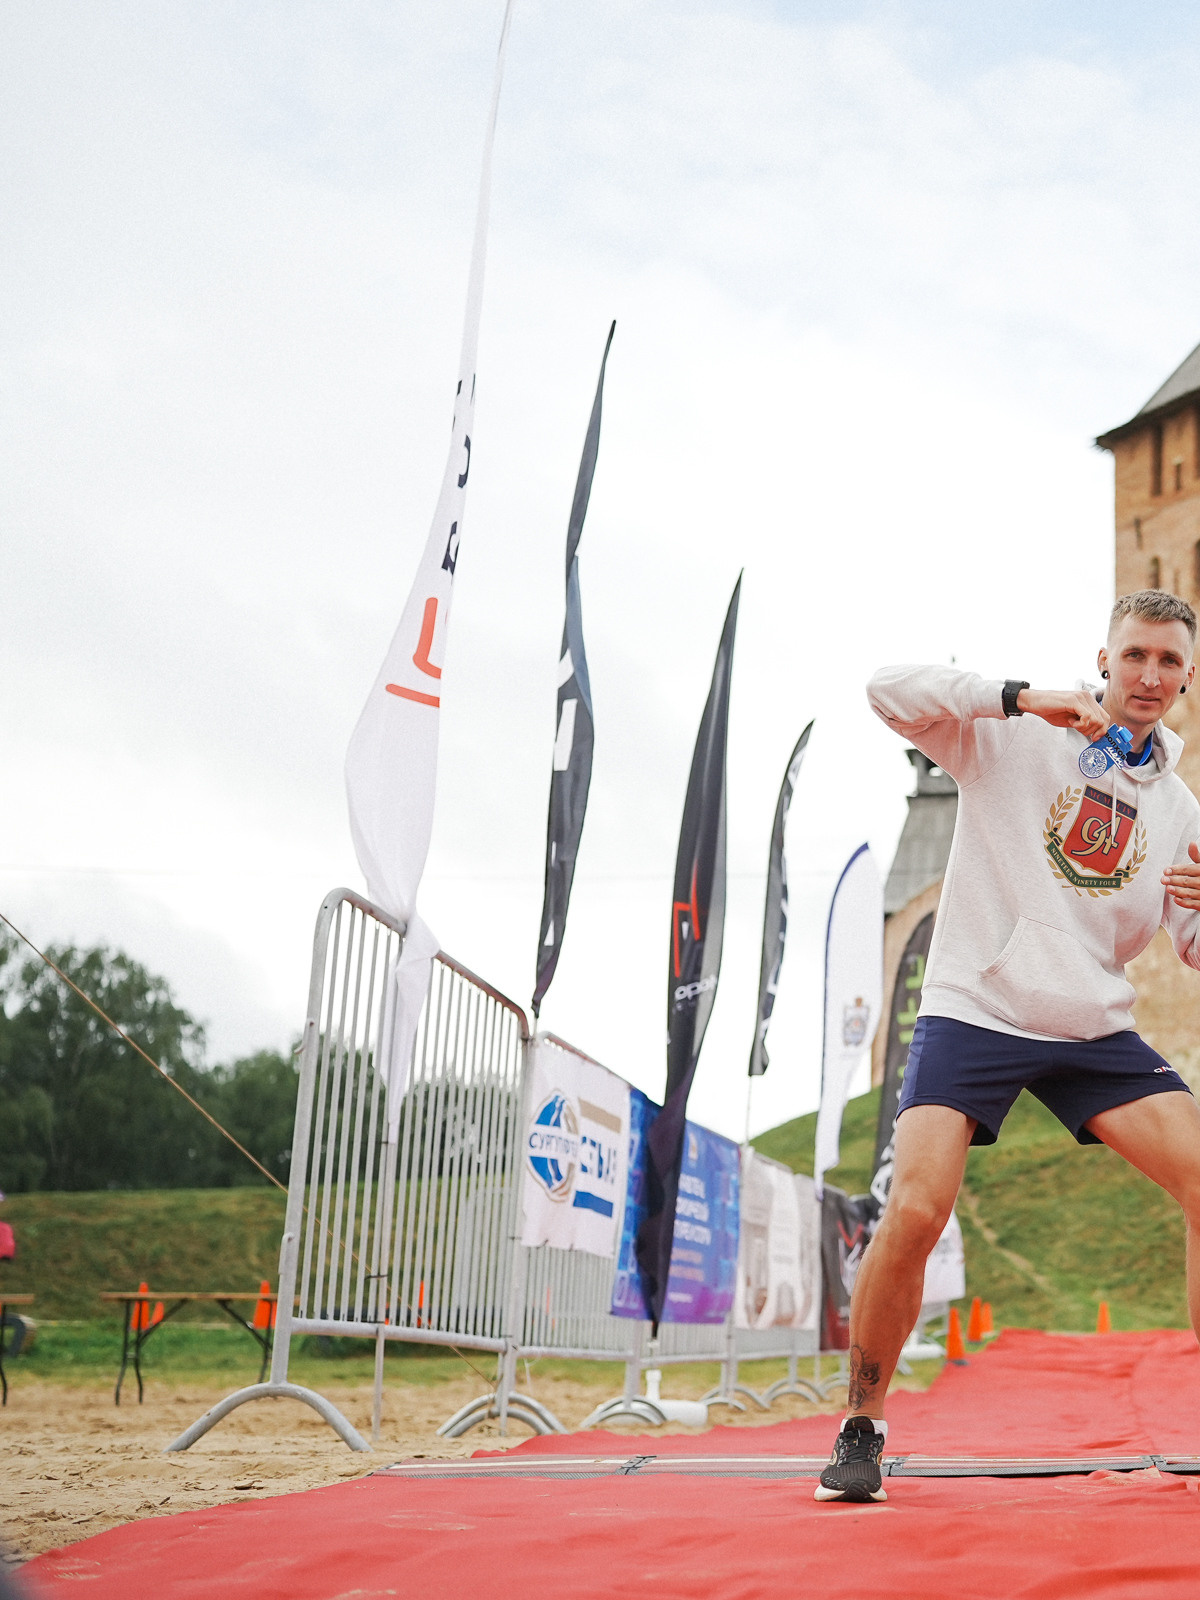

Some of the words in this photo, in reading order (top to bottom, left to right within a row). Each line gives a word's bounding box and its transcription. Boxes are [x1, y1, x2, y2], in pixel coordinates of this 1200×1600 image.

[1089, 788, 1133, 815] MCMCIV
[1051, 847, 1074, 878] NINETEEN
[1073, 875, 1098, 886] NINETY
